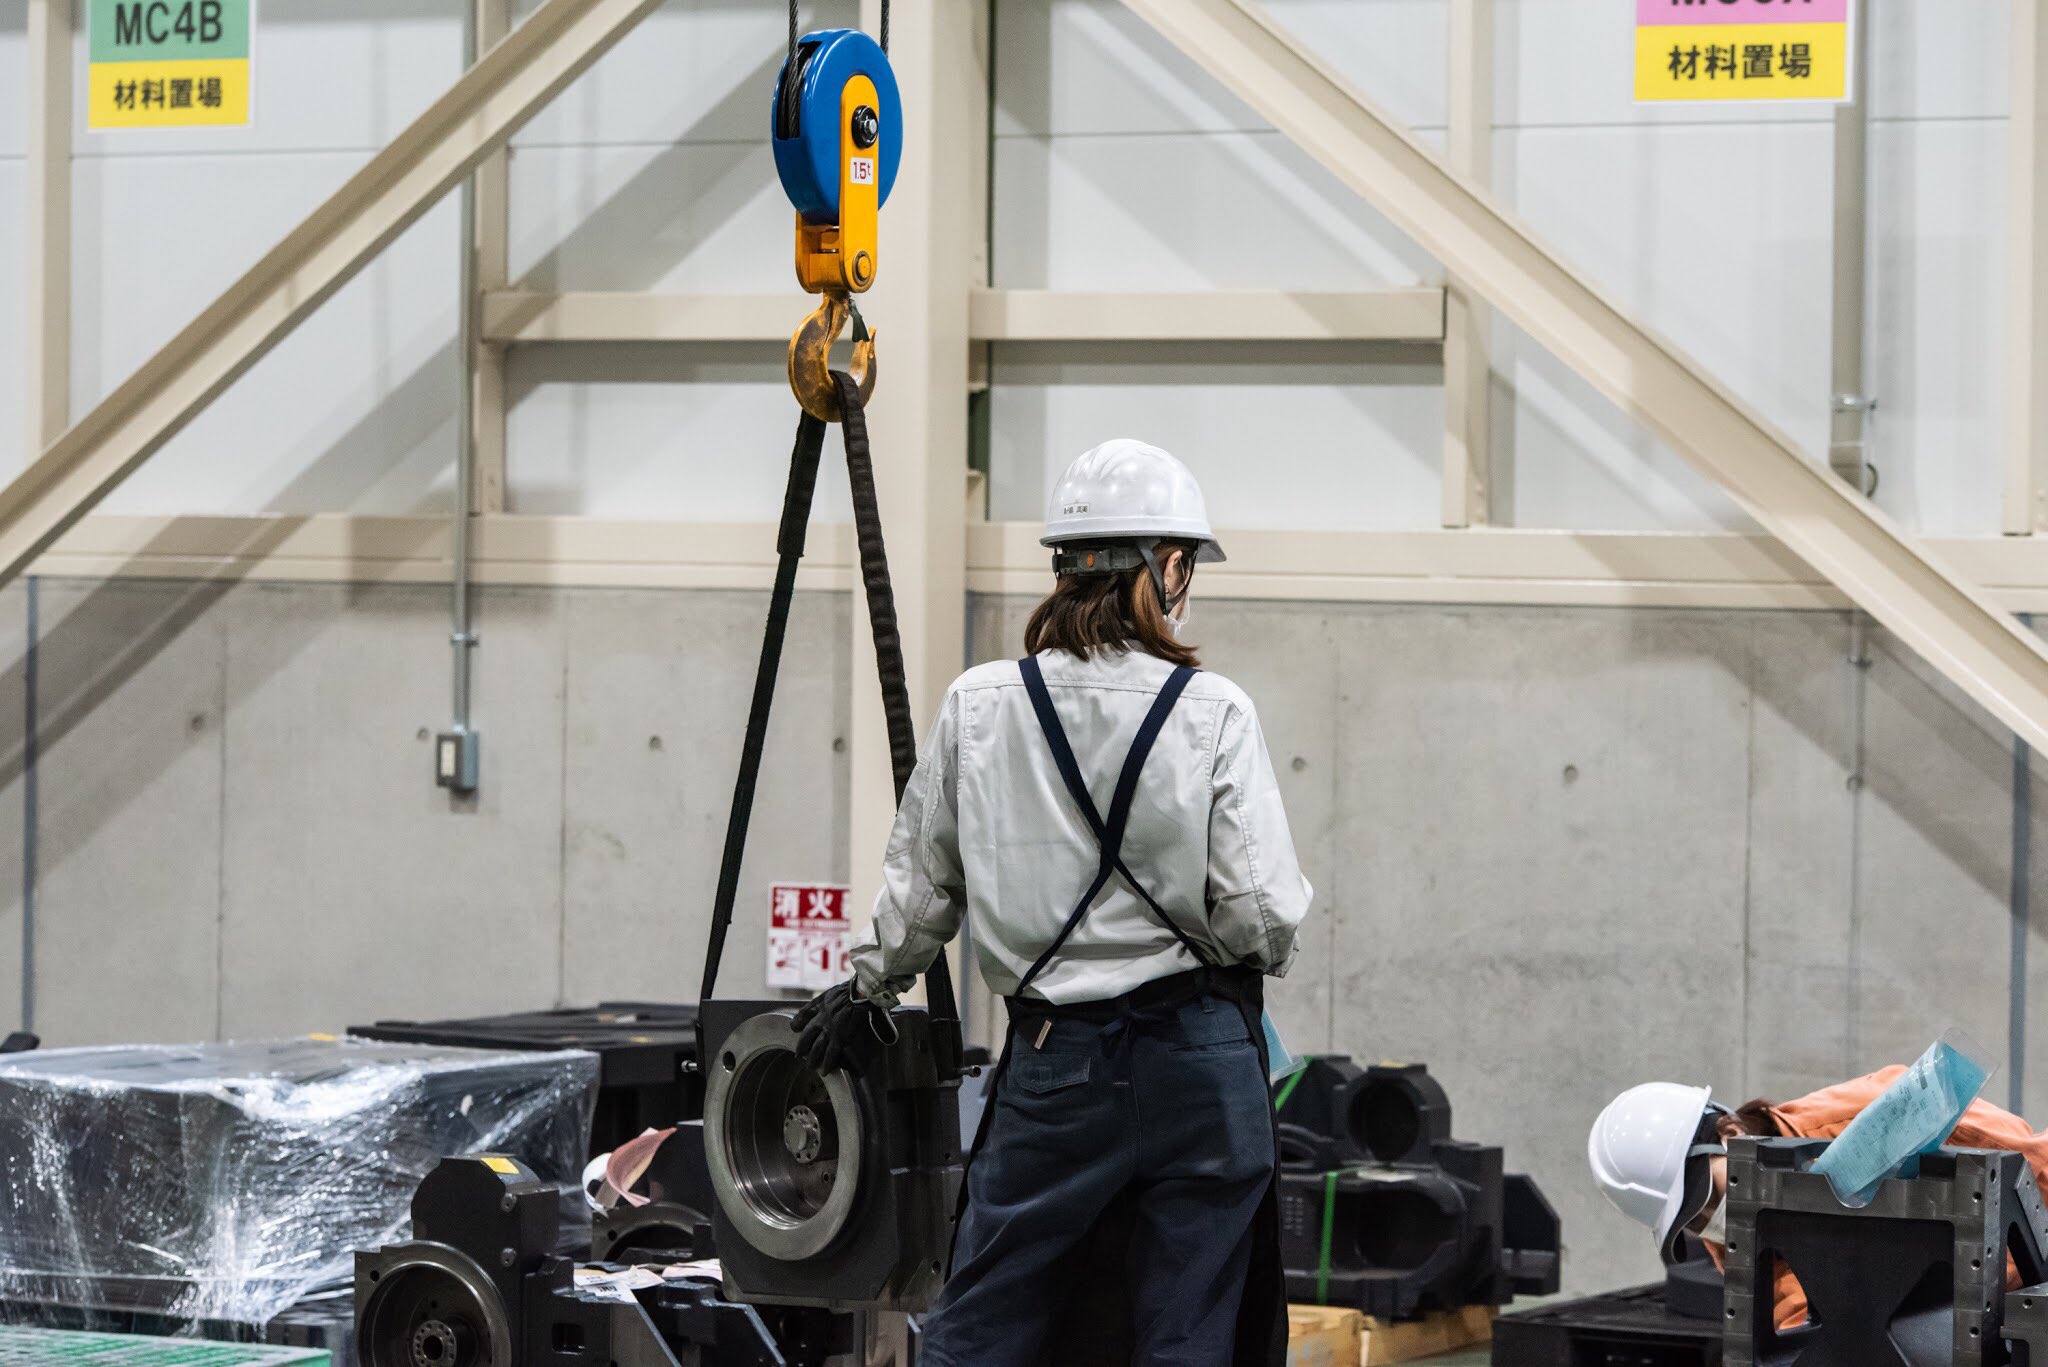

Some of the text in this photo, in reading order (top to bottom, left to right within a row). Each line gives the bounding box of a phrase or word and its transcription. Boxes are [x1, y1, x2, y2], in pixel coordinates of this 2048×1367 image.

[115, 0, 223, 46] MC4B
[1668, 43, 1812, 80] 材料置場
[113, 77, 222, 110] 材料置場
[774, 889, 850, 919] 消火
